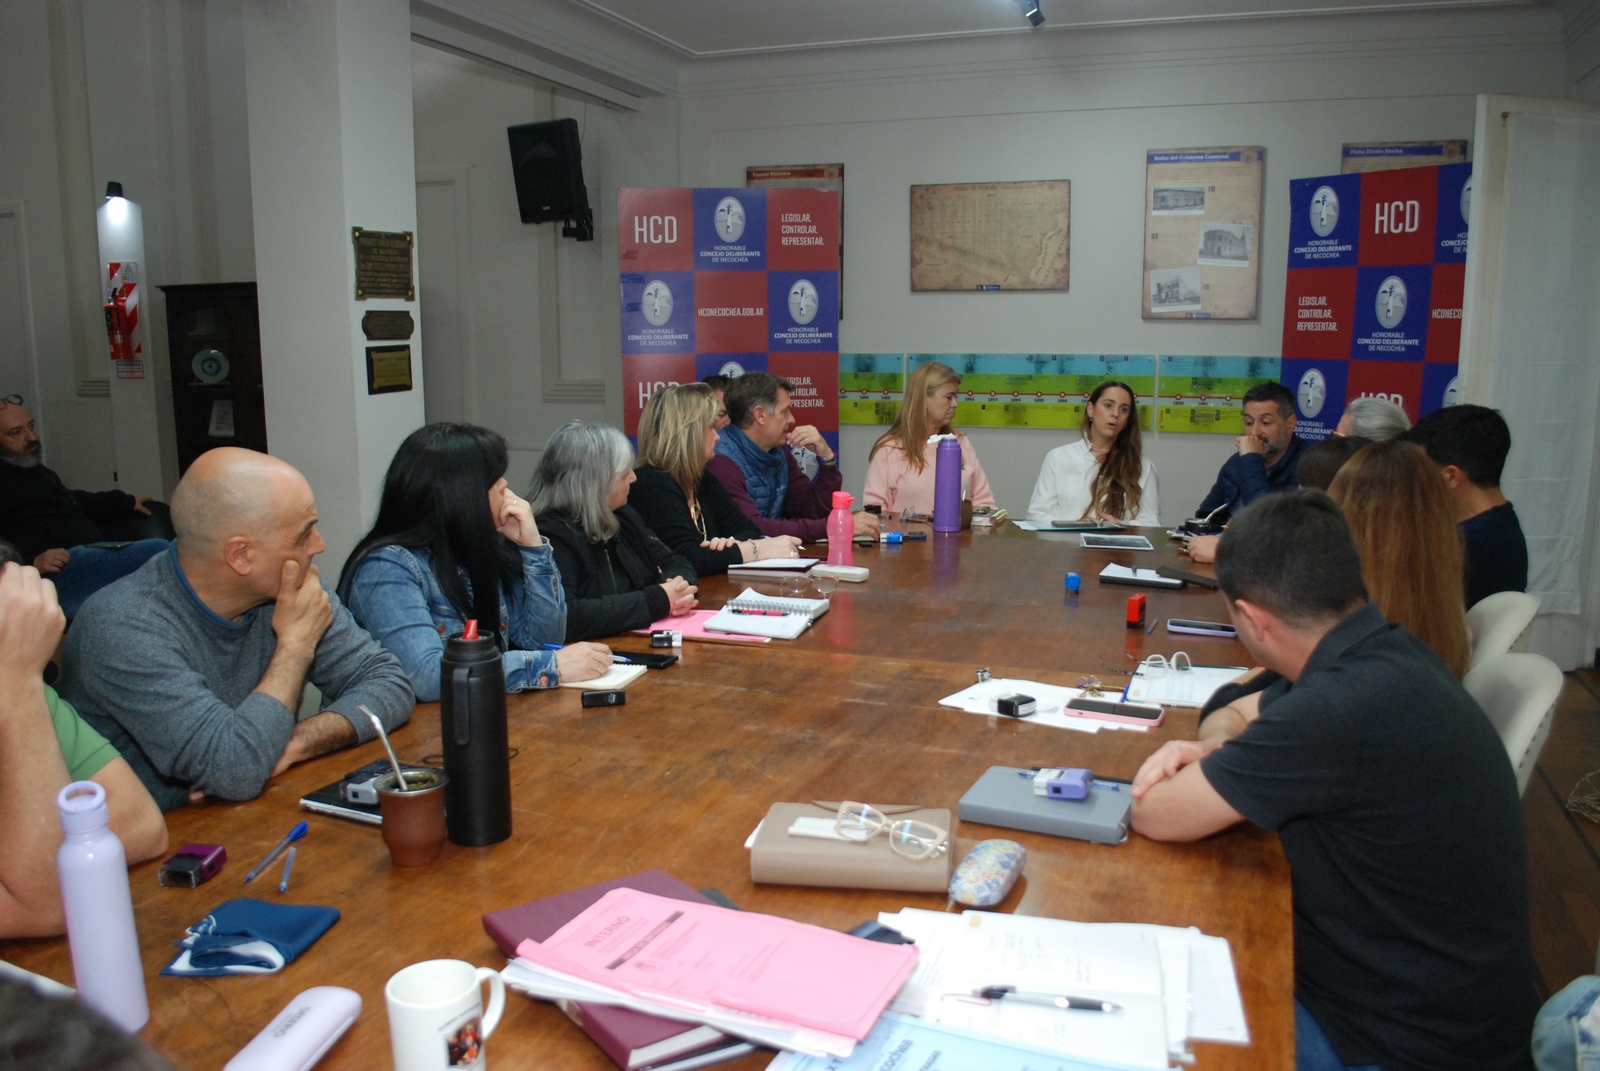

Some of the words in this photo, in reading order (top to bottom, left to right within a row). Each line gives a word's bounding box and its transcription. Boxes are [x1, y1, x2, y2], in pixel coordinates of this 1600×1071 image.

[781, 213, 811, 222] LEGISLAR.
[1375, 200, 1419, 233] HCD
[635, 216, 677, 243] HCD
[781, 225, 818, 234] CONTROLAR.
[781, 237, 824, 245] REPRESENTAR.
[1298, 296, 1327, 306] LEGISLAR.
[1298, 309, 1332, 318] CONTROLAR.
[1296, 322, 1338, 332] REPRESENTAR.
[790, 399, 825, 408] PRESENTAR.
[584, 916, 630, 948] INTERNO
